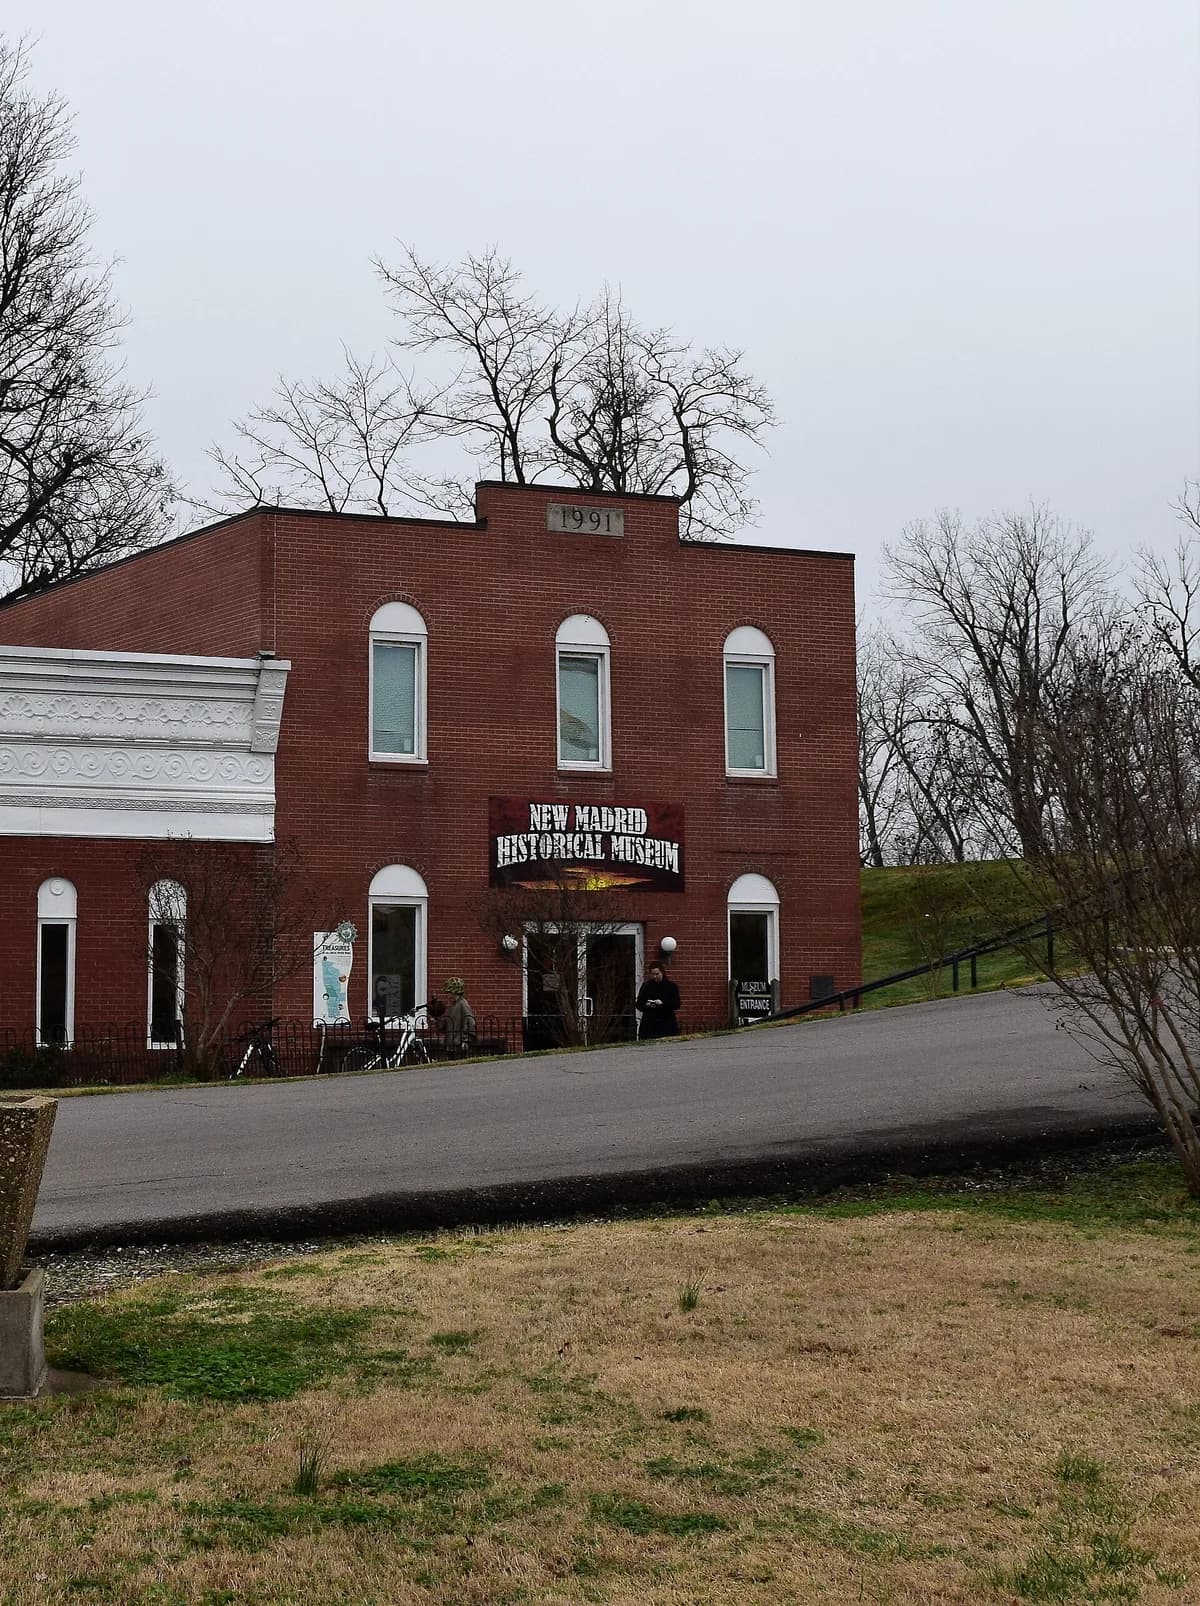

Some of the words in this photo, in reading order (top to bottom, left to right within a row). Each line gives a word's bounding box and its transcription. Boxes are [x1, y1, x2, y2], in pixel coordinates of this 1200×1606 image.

[561, 510, 611, 532] 1991
[529, 803, 569, 831] NEW
[574, 805, 648, 835] MADRID
[496, 833, 605, 868] HISTORICAL
[611, 835, 680, 874] MUSEUM
[741, 981, 767, 993] MUSEUM
[740, 999, 770, 1010] ENTRANCE
